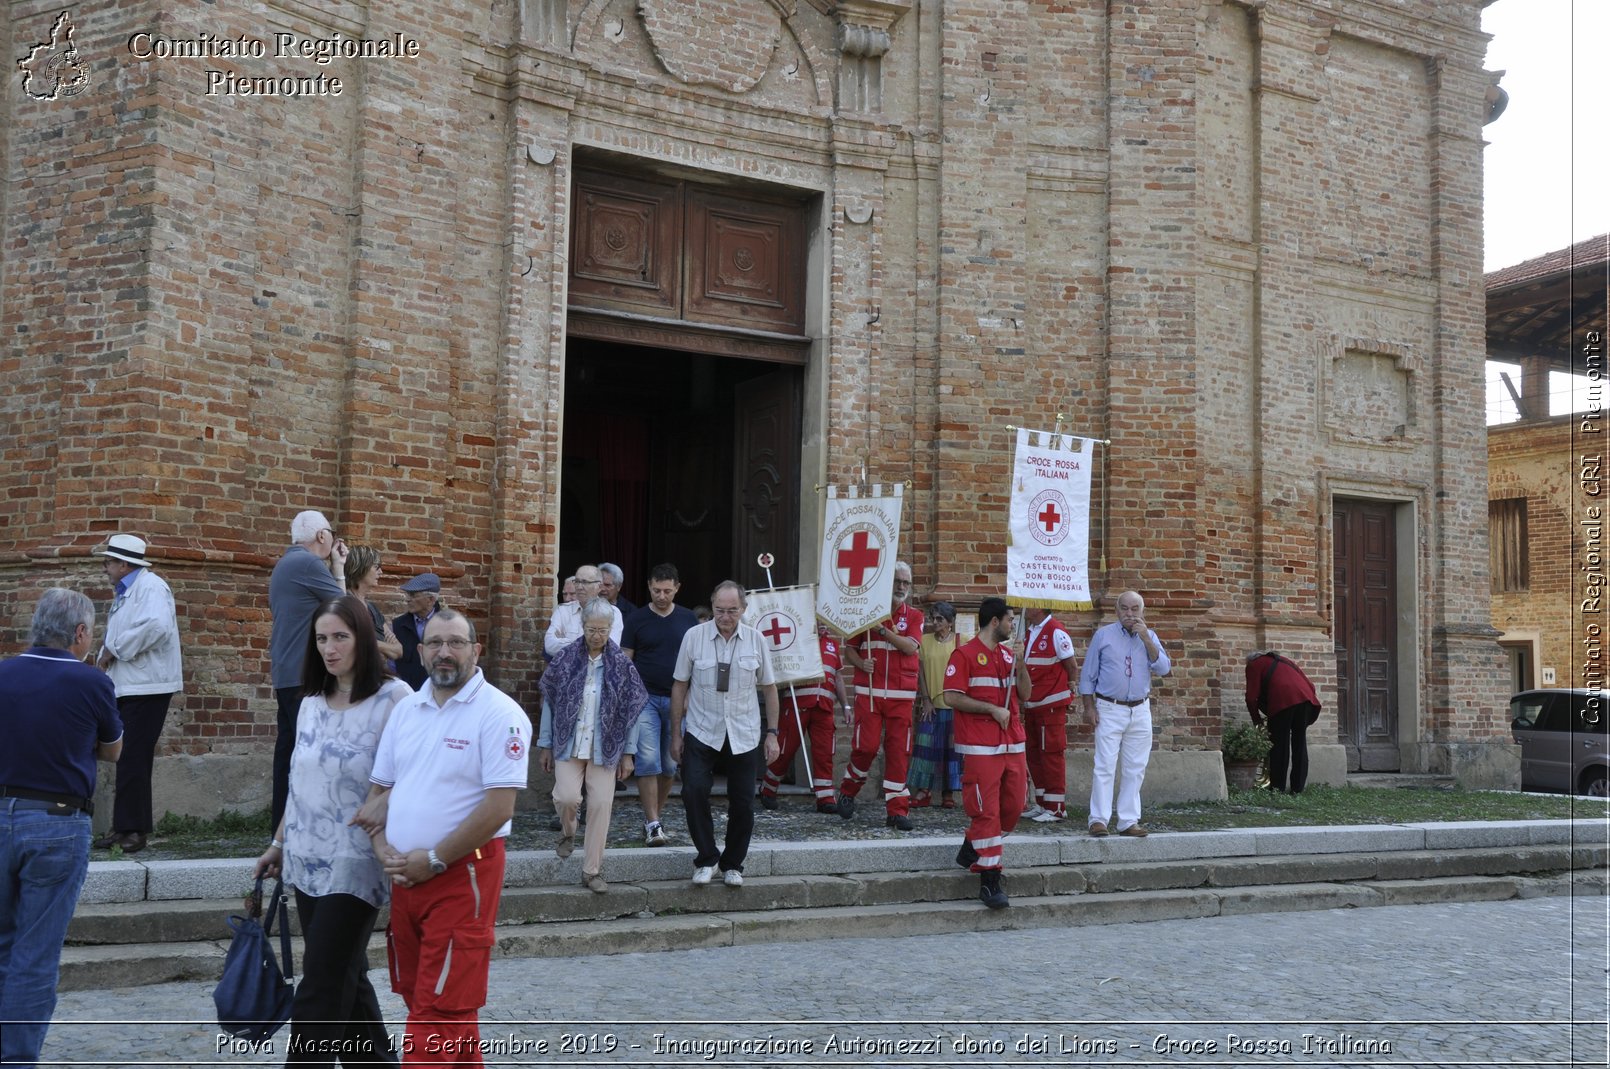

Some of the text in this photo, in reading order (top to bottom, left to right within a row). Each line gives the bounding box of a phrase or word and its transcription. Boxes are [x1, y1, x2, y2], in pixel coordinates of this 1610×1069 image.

[1026, 456, 1080, 470] CROCE ROSSA
[1035, 468, 1069, 480] ITALIANA
[826, 512, 846, 541] CROCE
[846, 504, 873, 517] ROSSA
[874, 507, 896, 542] ITALIANA
[1020, 562, 1077, 572] CASTELNUOVO
[1047, 573, 1072, 582] BOSCO
[1053, 583, 1083, 591] MASSAIA
[839, 596, 868, 605] COMITATO
[822, 602, 857, 629] VILLANOVA
